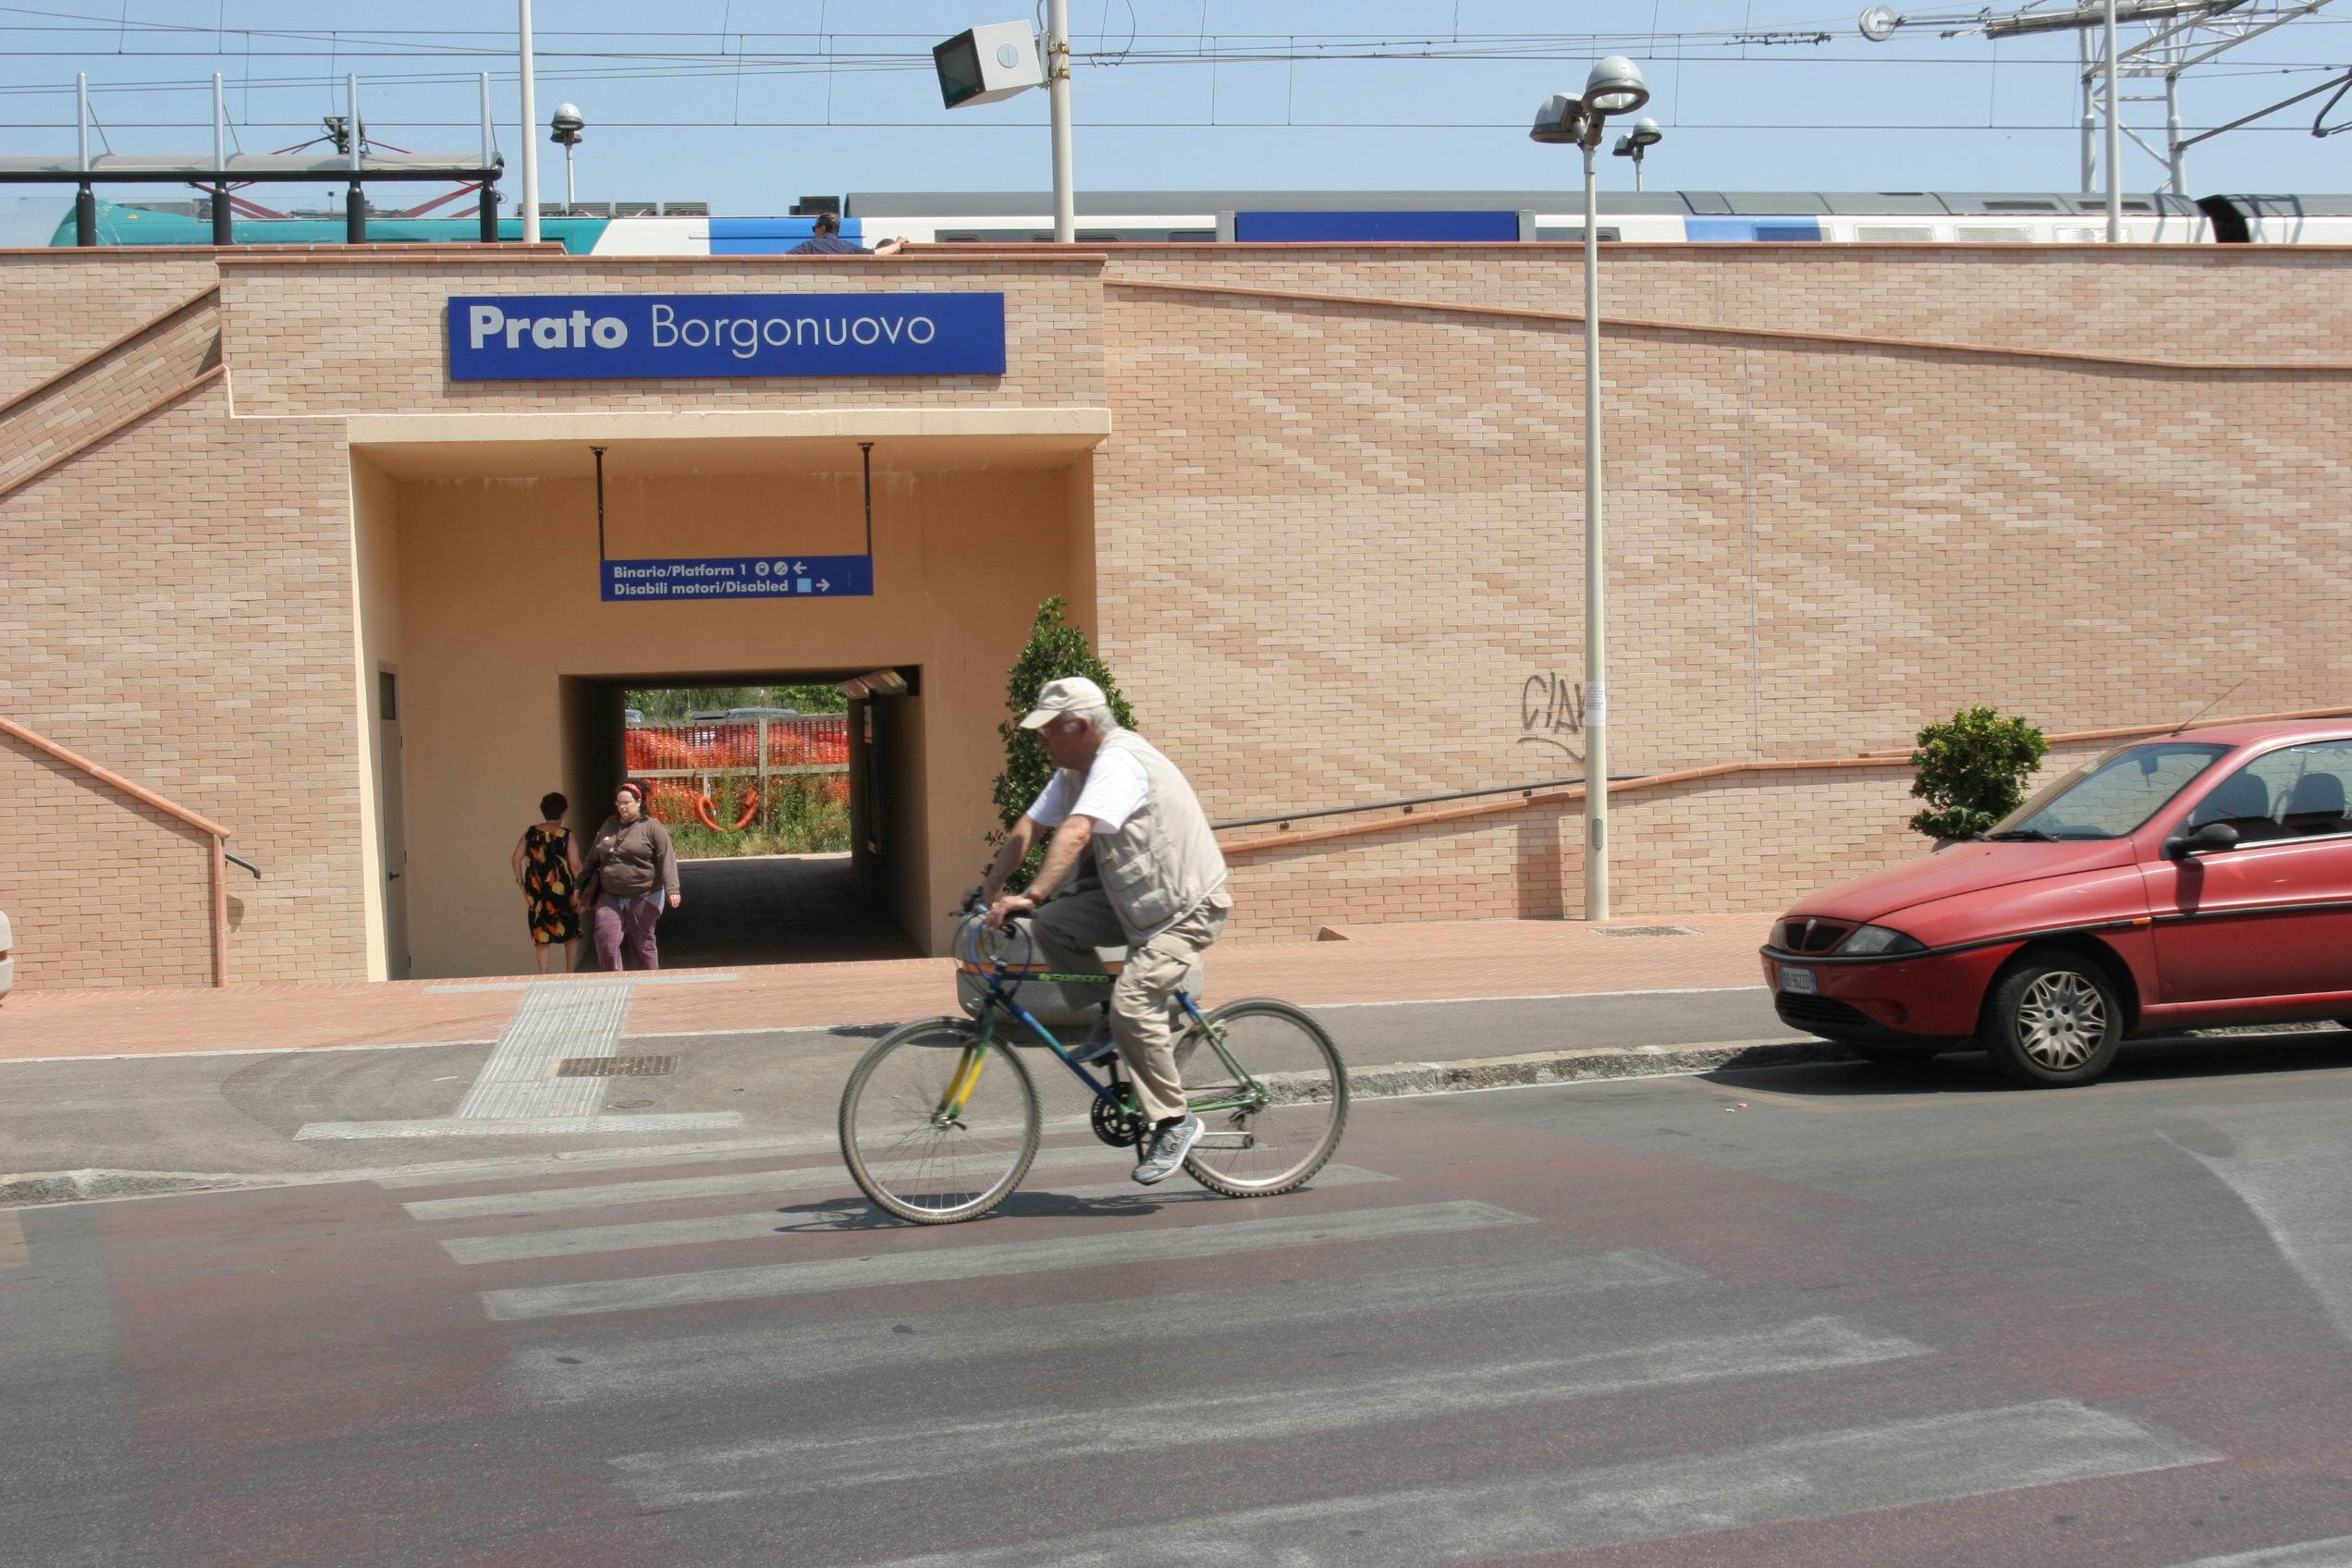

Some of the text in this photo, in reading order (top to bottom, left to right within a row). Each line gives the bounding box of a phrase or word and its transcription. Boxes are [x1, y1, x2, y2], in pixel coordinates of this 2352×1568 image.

[469, 304, 937, 360] Prato Borgonuovo
[613, 564, 747, 579] Binario/Platform 1
[614, 579, 790, 595] Disabili motori/Disabled
